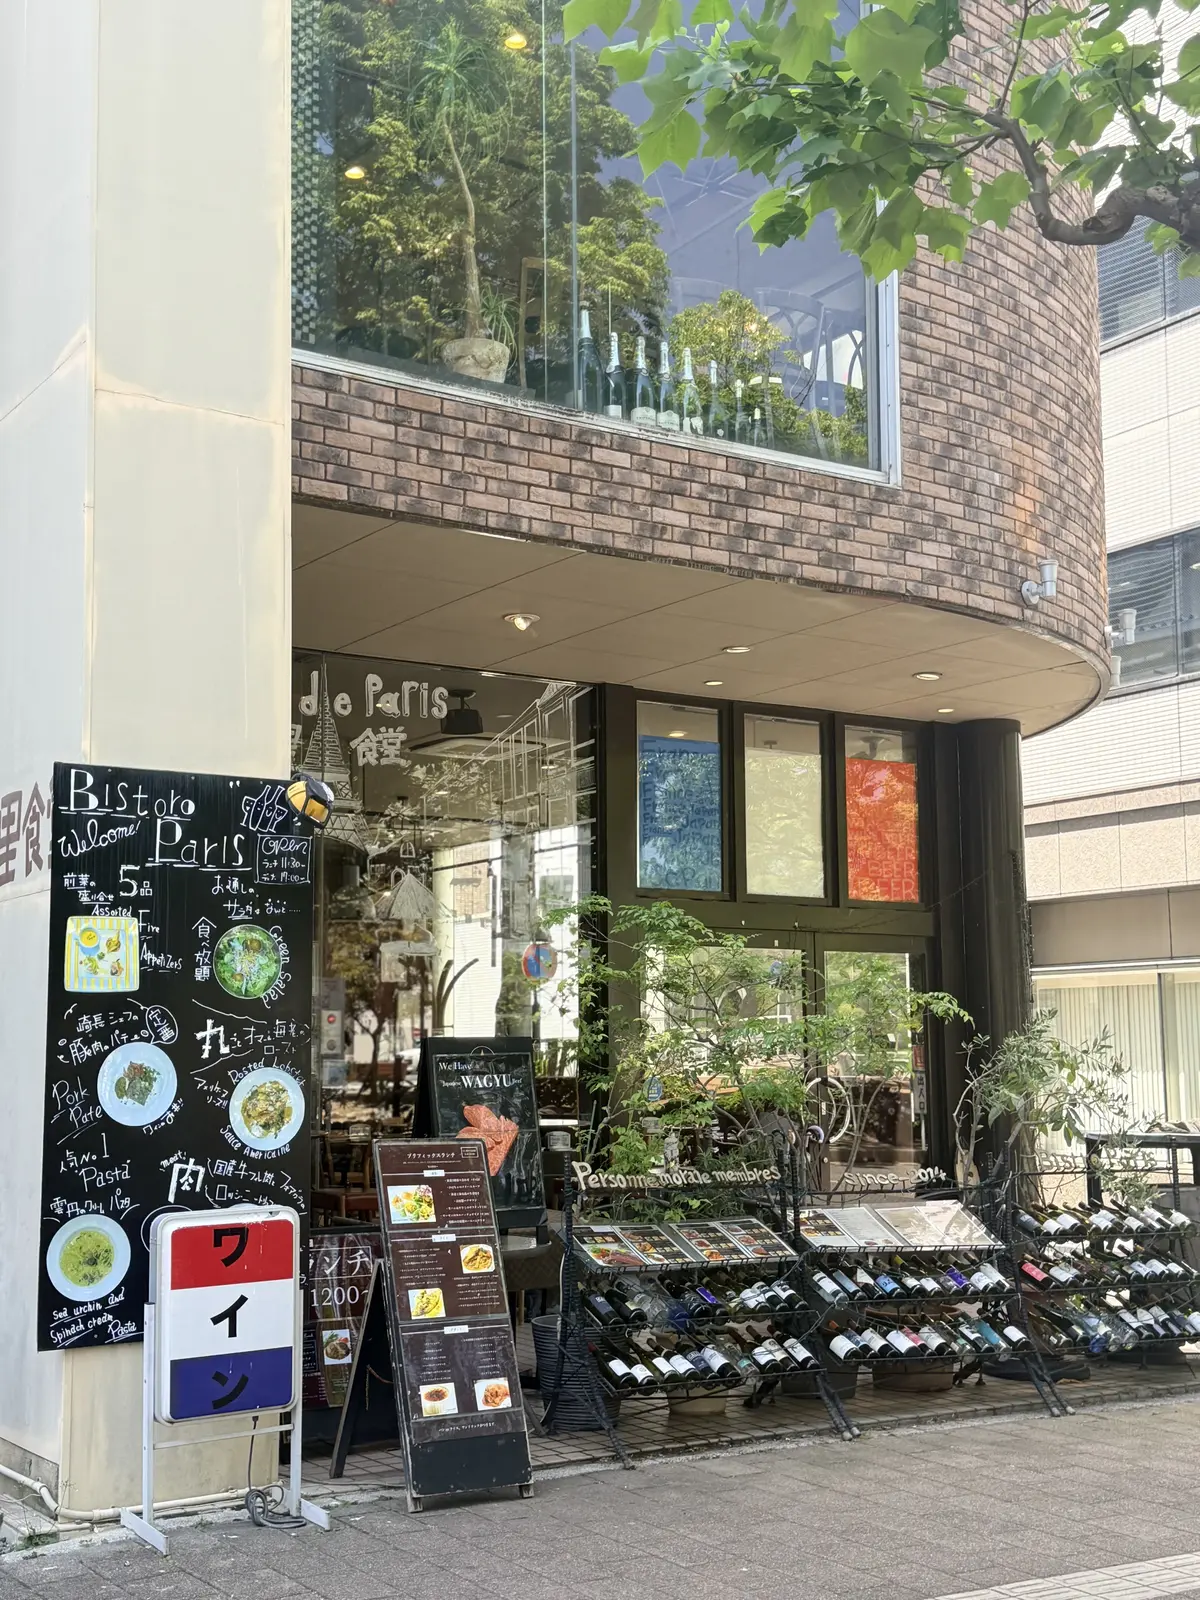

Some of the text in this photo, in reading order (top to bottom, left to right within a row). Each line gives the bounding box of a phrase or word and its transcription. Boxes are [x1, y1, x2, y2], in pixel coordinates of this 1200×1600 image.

[298, 670, 450, 719] de Paris
[57, 818, 142, 857] Welcome!
[155, 818, 245, 863] Paris
[62, 872, 97, 888] 前菜の
[211, 874, 255, 894] お通しの
[191, 916, 218, 982] 食べ放題
[261, 925, 292, 1009] Green Salad
[148, 1008, 176, 1042] 定番
[438, 1061, 452, 1071] We
[460, 1074, 513, 1089] WAGYU
[52, 1075, 91, 1111] Pork
[69, 1104, 104, 1129] Pate
[219, 1124, 242, 1151] Sauce
[167, 1157, 206, 1204] 肉
[711, 1161, 782, 1185] membres
[52, 1286, 126, 1321] Sea urchin and
[210, 1226, 250, 1410] ワイン
[49, 1312, 114, 1344] Spinach cream
[107, 1319, 137, 1341] Pasta
